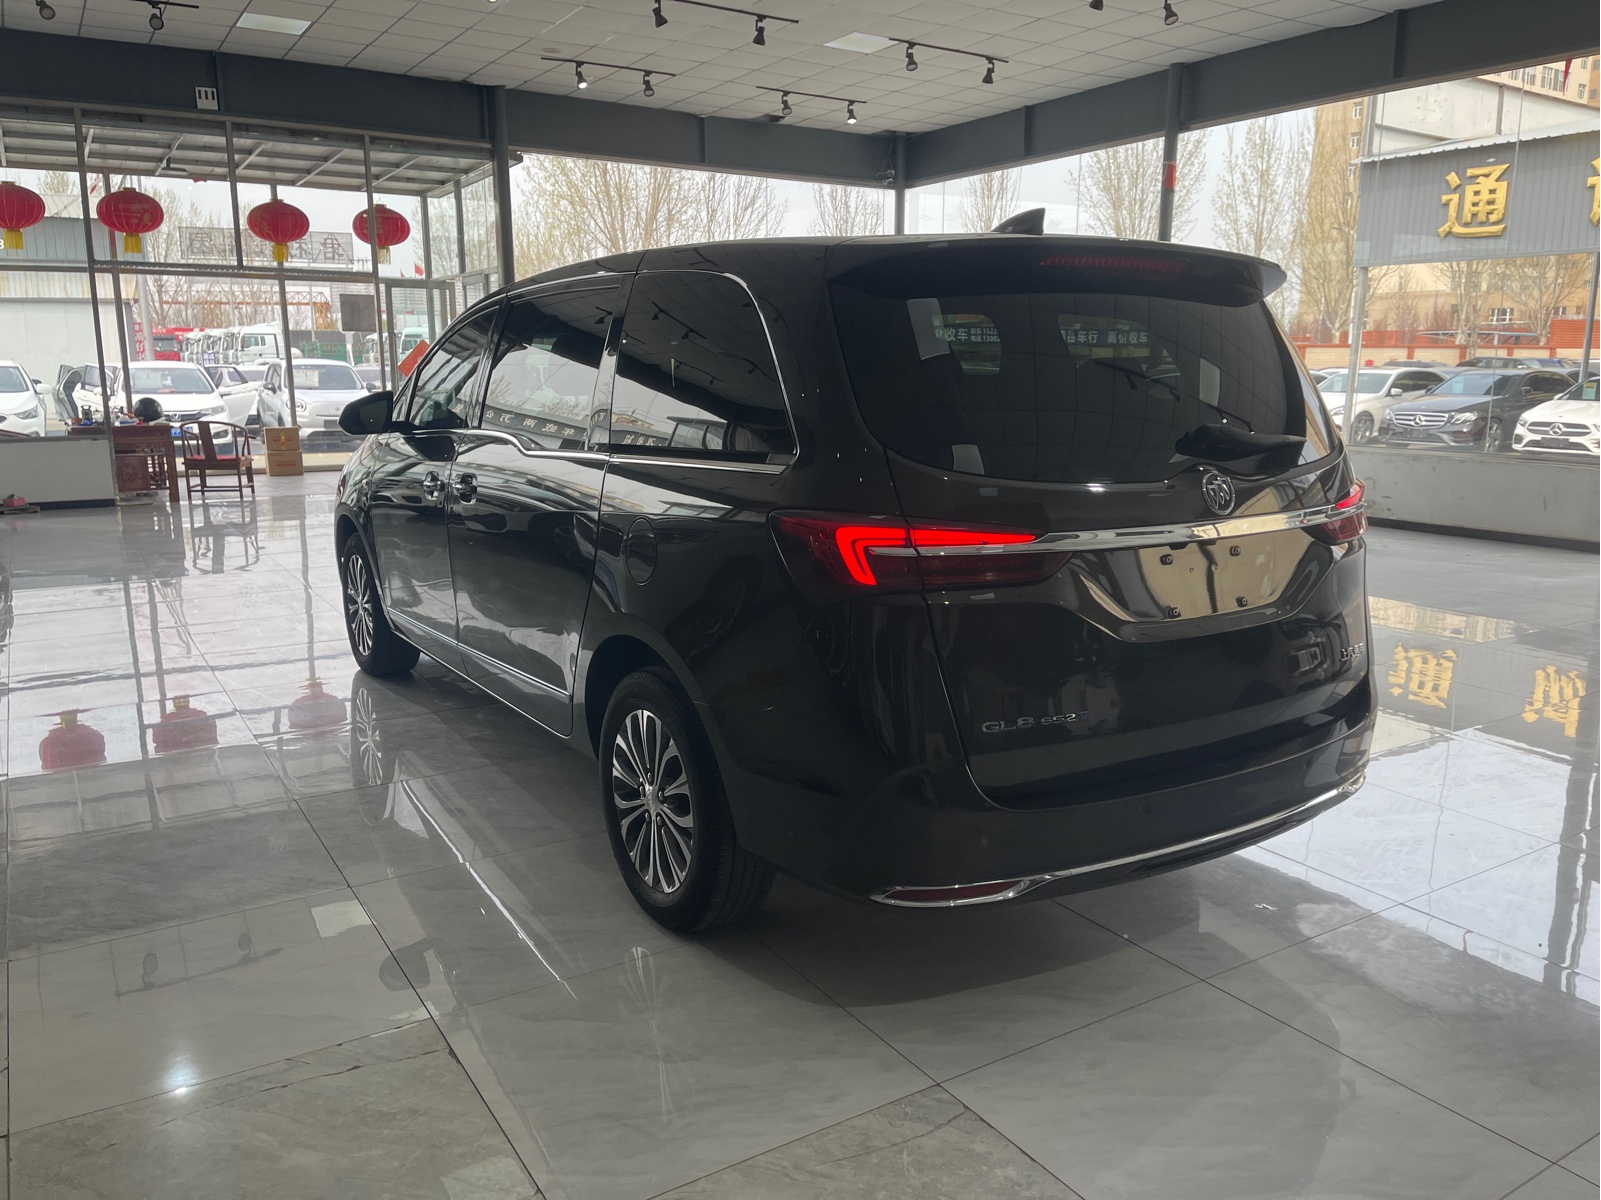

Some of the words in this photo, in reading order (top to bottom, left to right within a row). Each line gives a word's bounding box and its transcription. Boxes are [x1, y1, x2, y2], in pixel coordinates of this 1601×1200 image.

[1107, 331, 1149, 344] 高价收车
[981, 716, 1035, 733] GL8
